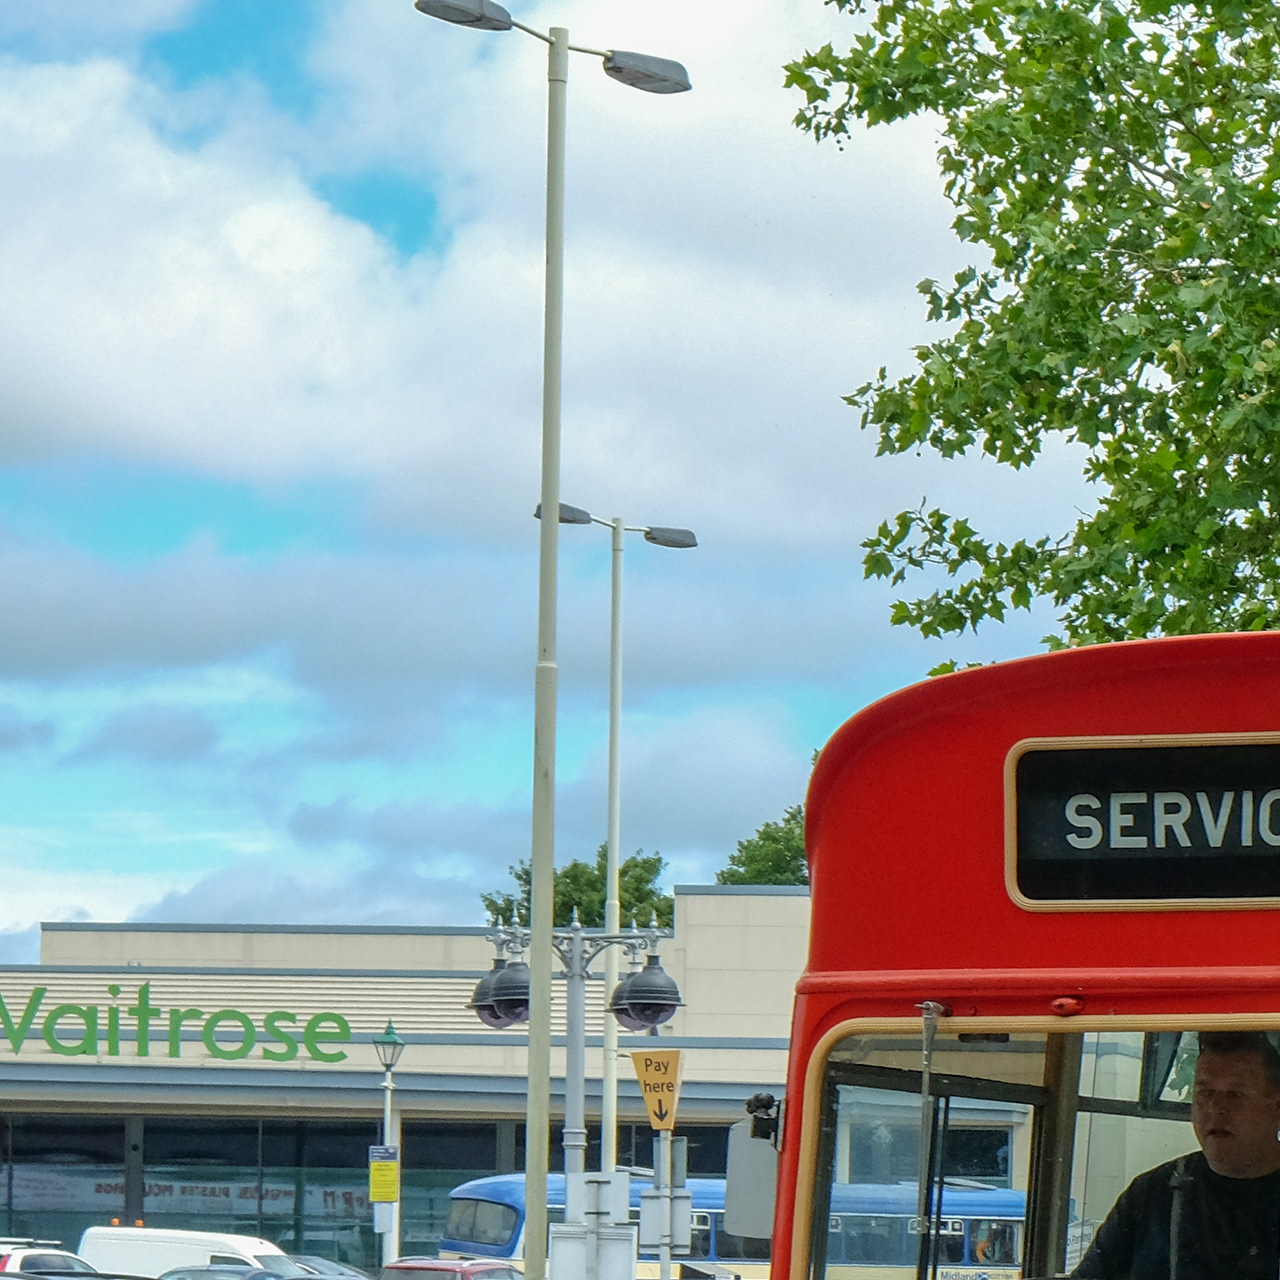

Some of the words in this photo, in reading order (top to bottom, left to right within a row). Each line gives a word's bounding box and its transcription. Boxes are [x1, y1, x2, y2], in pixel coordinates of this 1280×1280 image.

[644, 1058, 669, 1075] Pay
[643, 1080, 674, 1093] here
[941, 1271, 978, 1280] Midland
